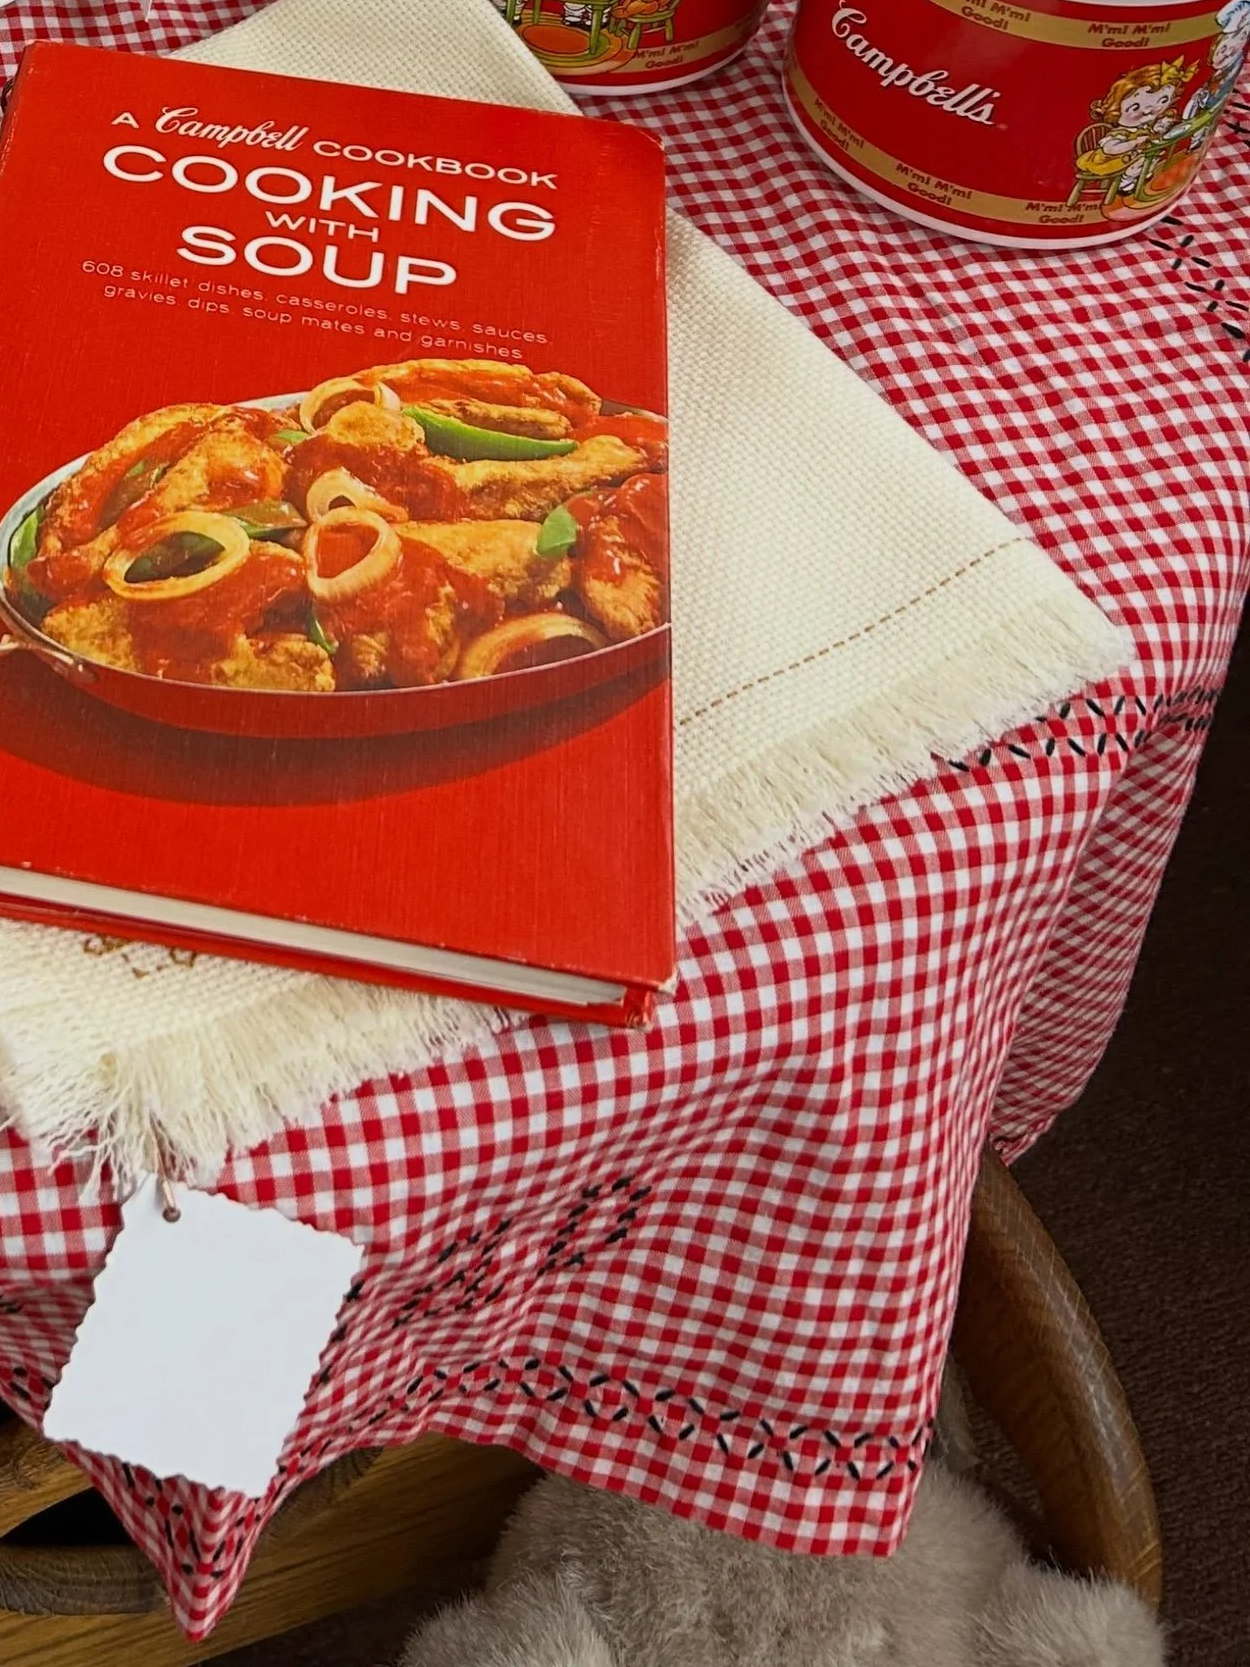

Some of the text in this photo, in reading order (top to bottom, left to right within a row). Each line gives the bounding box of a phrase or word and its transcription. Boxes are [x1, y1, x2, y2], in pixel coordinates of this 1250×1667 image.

[961, 5, 1010, 32] Good!
[989, 1, 1031, 23] M'm!
[1087, 22, 1172, 35] M'm! M'm!
[1101, 37, 1150, 49] Good!
[111, 106, 558, 190] A Campbell COOKBOOK
[103, 145, 556, 242] COOKING
[895, 163, 974, 200] M'm! M'm!
[906, 182, 953, 206] Good!
[264, 210, 380, 244] WITH
[1038, 214, 1085, 224] Good!
[176, 224, 457, 295] SOUP
[82, 260, 125, 278] 608
[130, 269, 188, 288] skillet
[242, 307, 293, 324] soup
[301, 315, 366, 335] mates
[373, 326, 413, 342] and
[420, 334, 523, 360] garnishes
